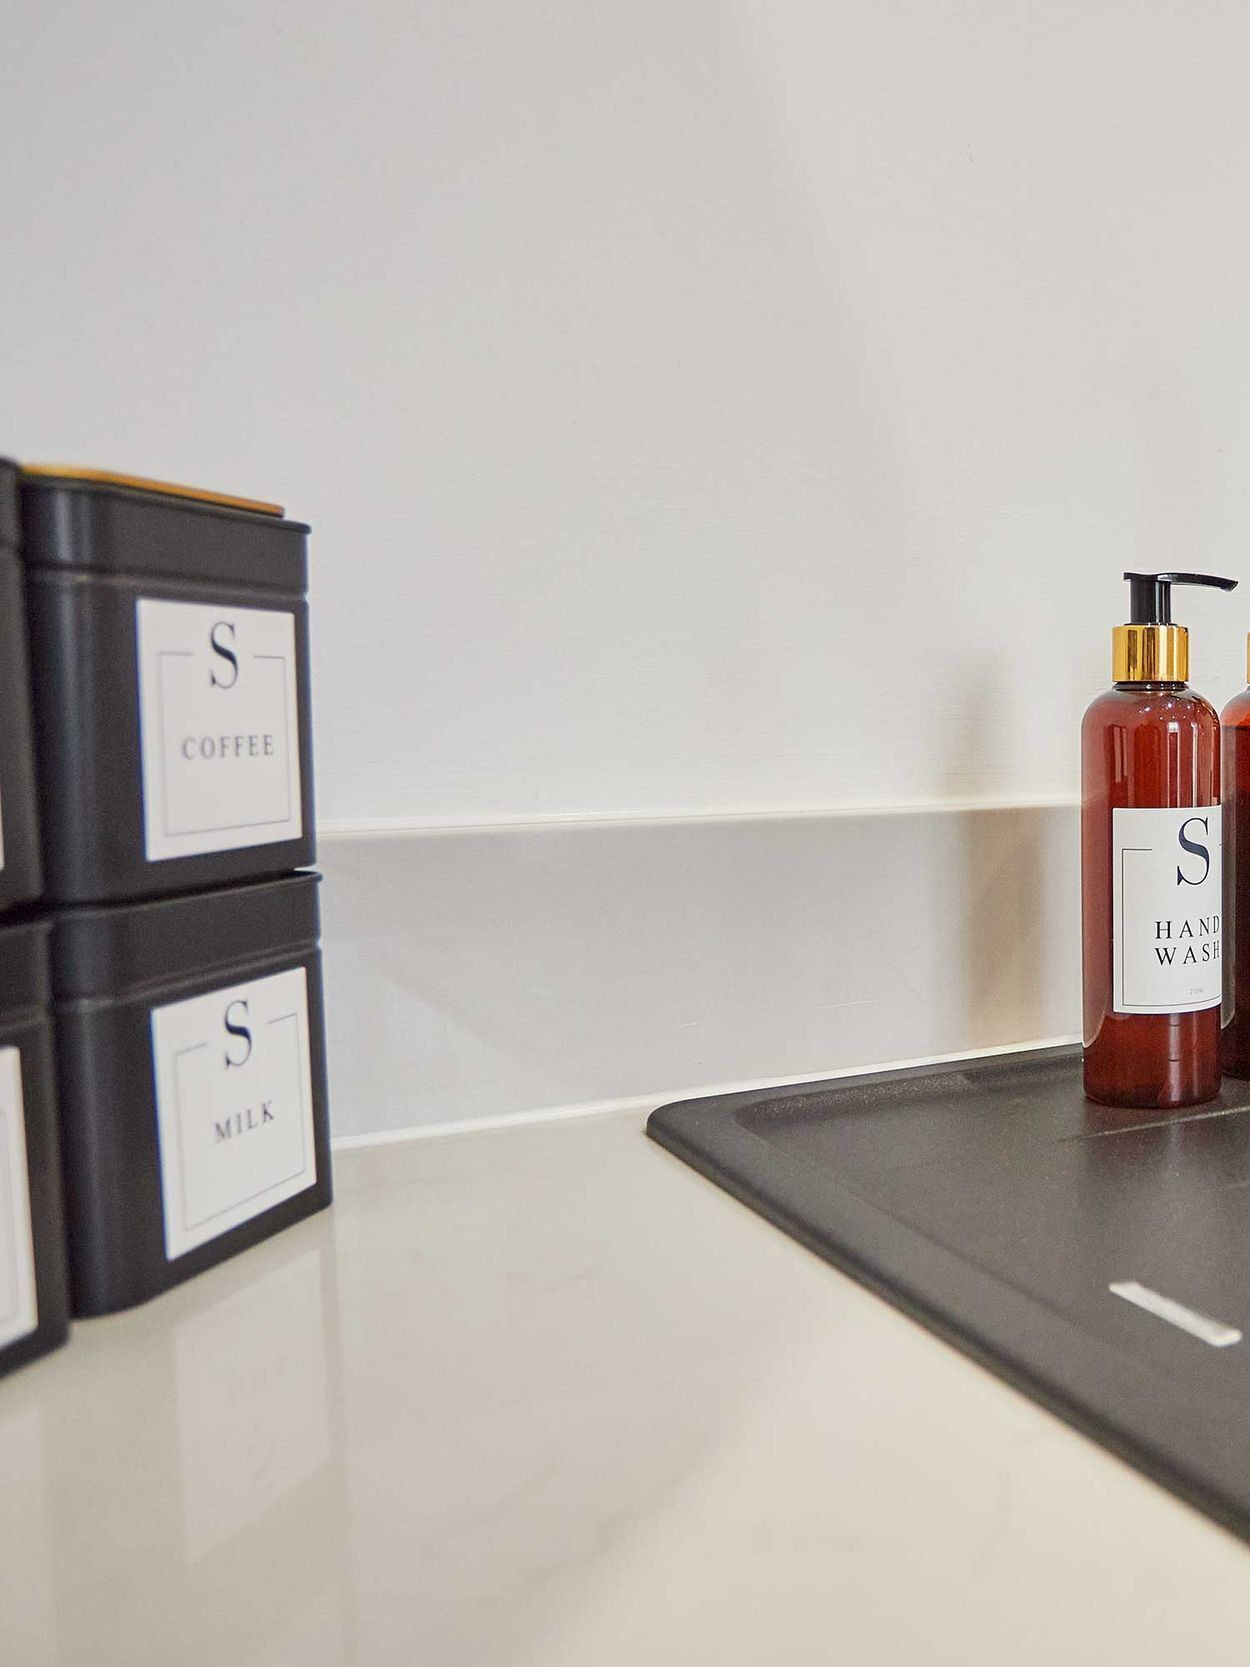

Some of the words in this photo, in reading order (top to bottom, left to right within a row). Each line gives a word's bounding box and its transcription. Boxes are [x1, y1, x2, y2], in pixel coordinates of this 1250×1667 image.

[210, 621, 238, 690] S
[181, 734, 274, 761] COFFEE
[1176, 817, 1210, 886] S
[1155, 915, 1220, 940] HAND
[1154, 940, 1220, 966] WASH
[224, 999, 252, 1068] S
[214, 1100, 275, 1144] MILK
